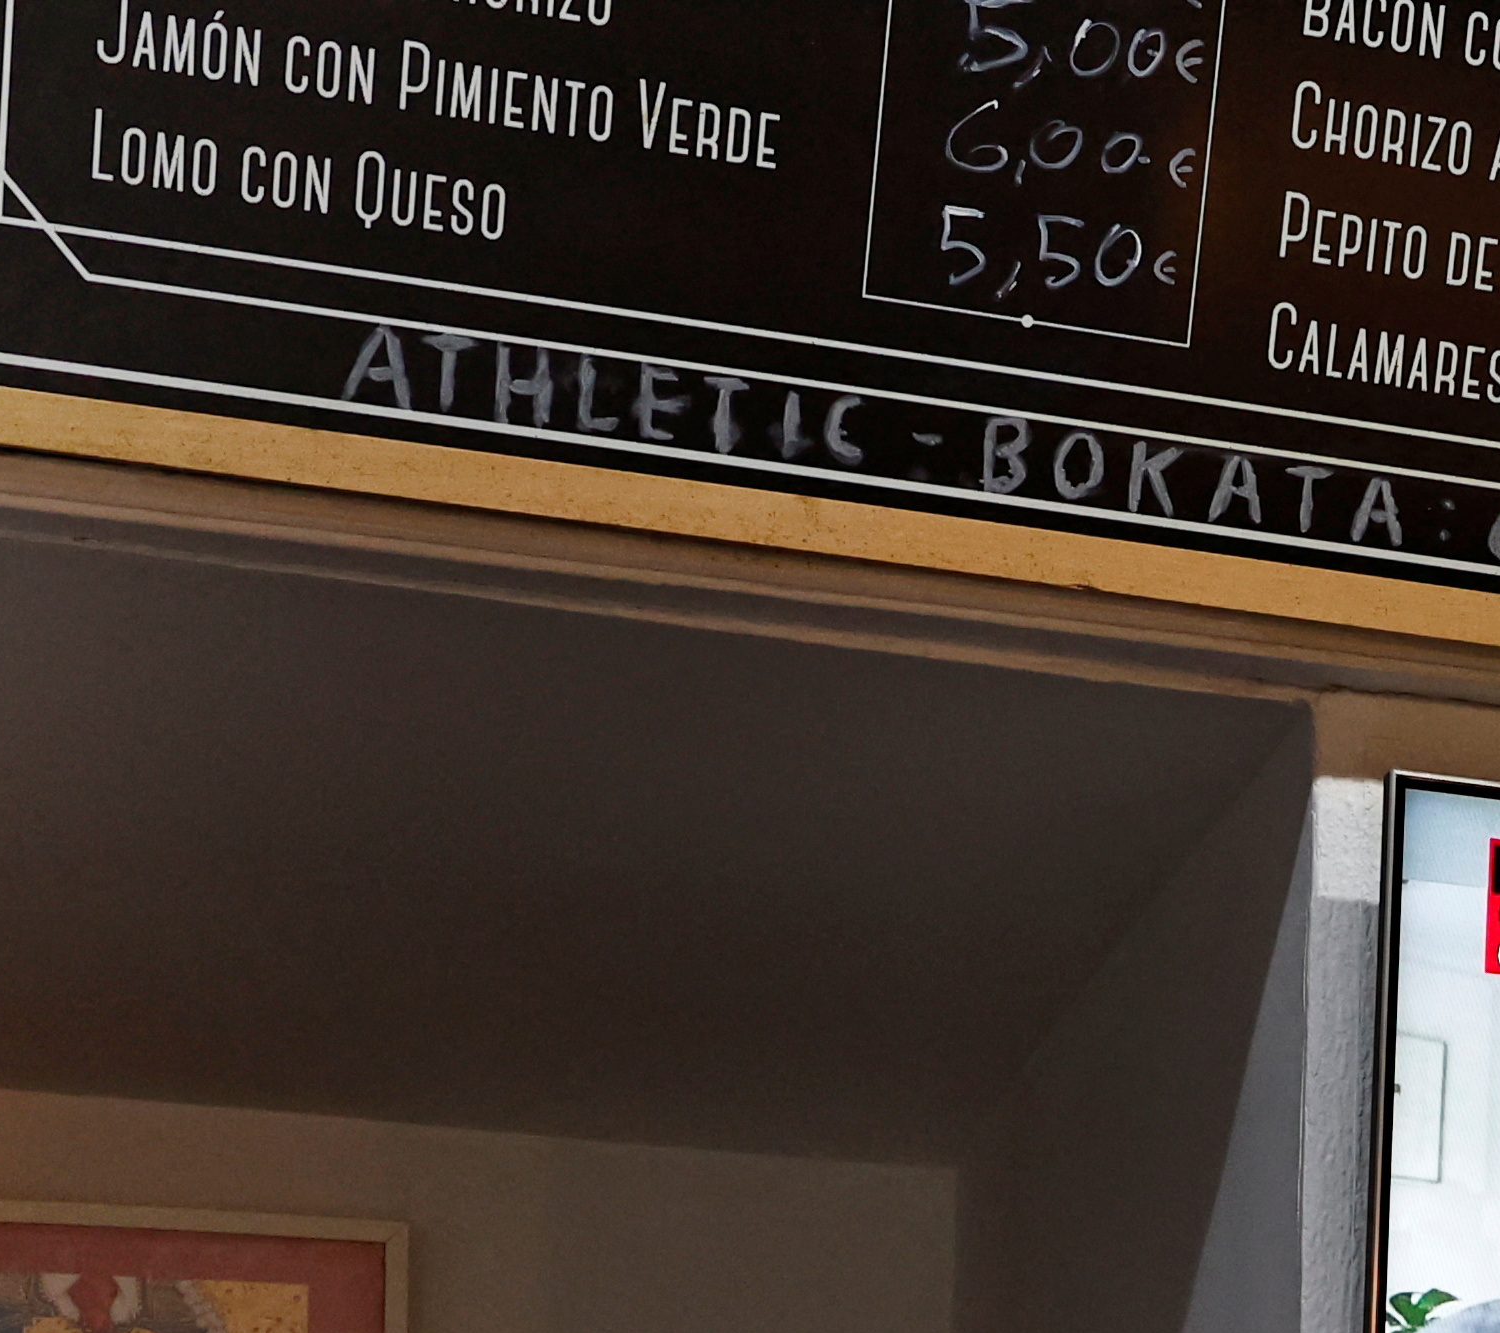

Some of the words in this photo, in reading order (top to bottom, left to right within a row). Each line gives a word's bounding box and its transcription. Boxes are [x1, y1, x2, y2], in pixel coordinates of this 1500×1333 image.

[97, 0, 261, 86] JAMÓN
[285, 36, 375, 104] CON
[400, 40, 613, 141] PIMIENTO
[640, 79, 780, 169] VERDE
[1292, 81, 1471, 175] CHORIZO
[92, 109, 217, 195] LOMO
[242, 146, 331, 213] CON
[356, 151, 505, 239] QUESO
[1280, 191, 1427, 279] PEPITO
[1446, 232, 1498, 291] DE
